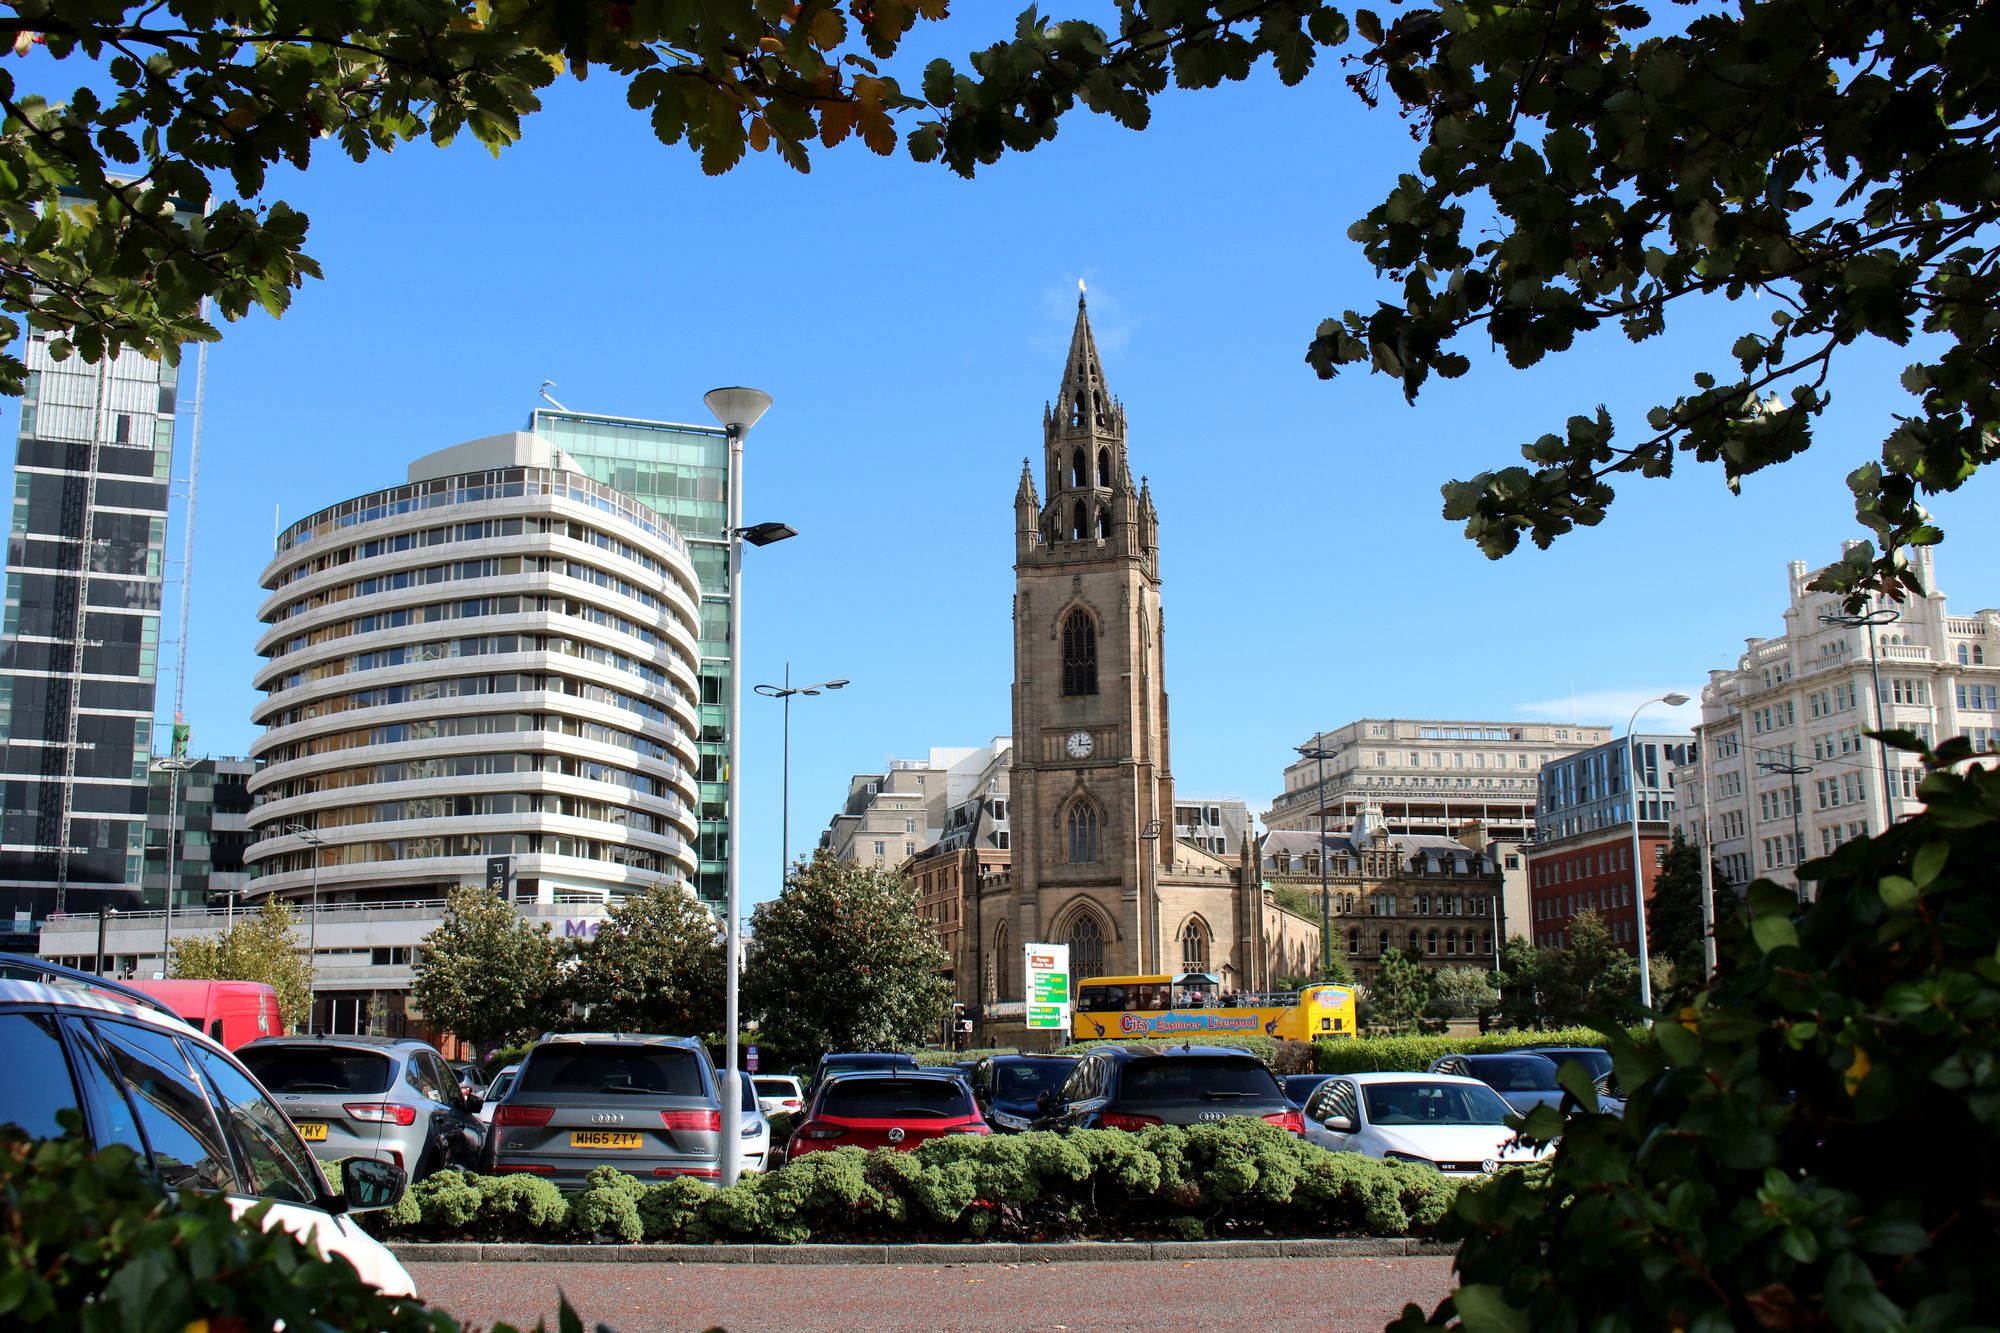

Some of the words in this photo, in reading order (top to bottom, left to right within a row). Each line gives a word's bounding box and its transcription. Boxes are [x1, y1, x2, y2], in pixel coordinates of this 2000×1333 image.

[566, 919, 600, 938] Me
[1121, 1014, 1149, 1033] City
[1156, 1019, 1201, 1032] Explorer
[1208, 1017, 1257, 1029] Liverpool
[576, 1133, 609, 1145] MH65
[612, 1133, 637, 1145] ZTY
